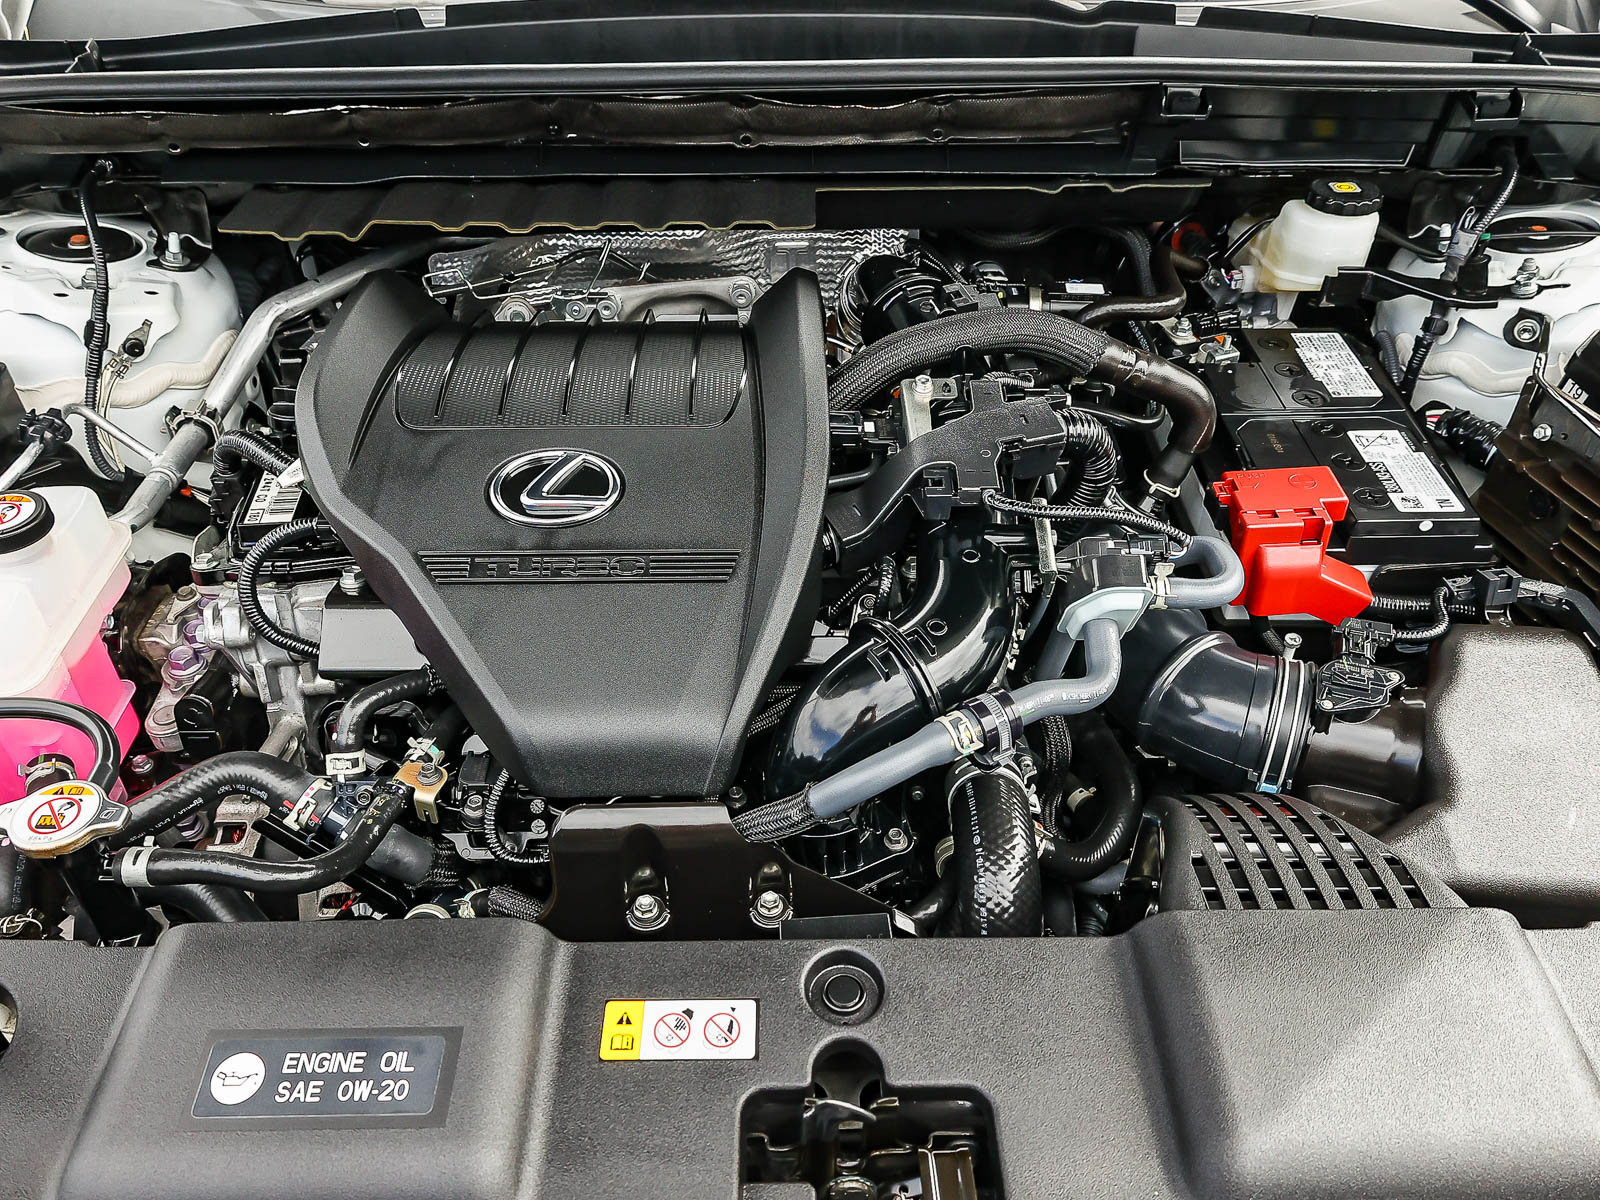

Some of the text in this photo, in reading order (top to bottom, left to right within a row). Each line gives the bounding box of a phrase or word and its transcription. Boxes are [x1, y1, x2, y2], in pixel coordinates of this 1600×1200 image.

[1567, 381, 1584, 400] 19
[474, 556, 646, 577] TURBO
[281, 1050, 415, 1074] ENGINE OIL
[273, 1079, 411, 1103] SAE 0W-20
